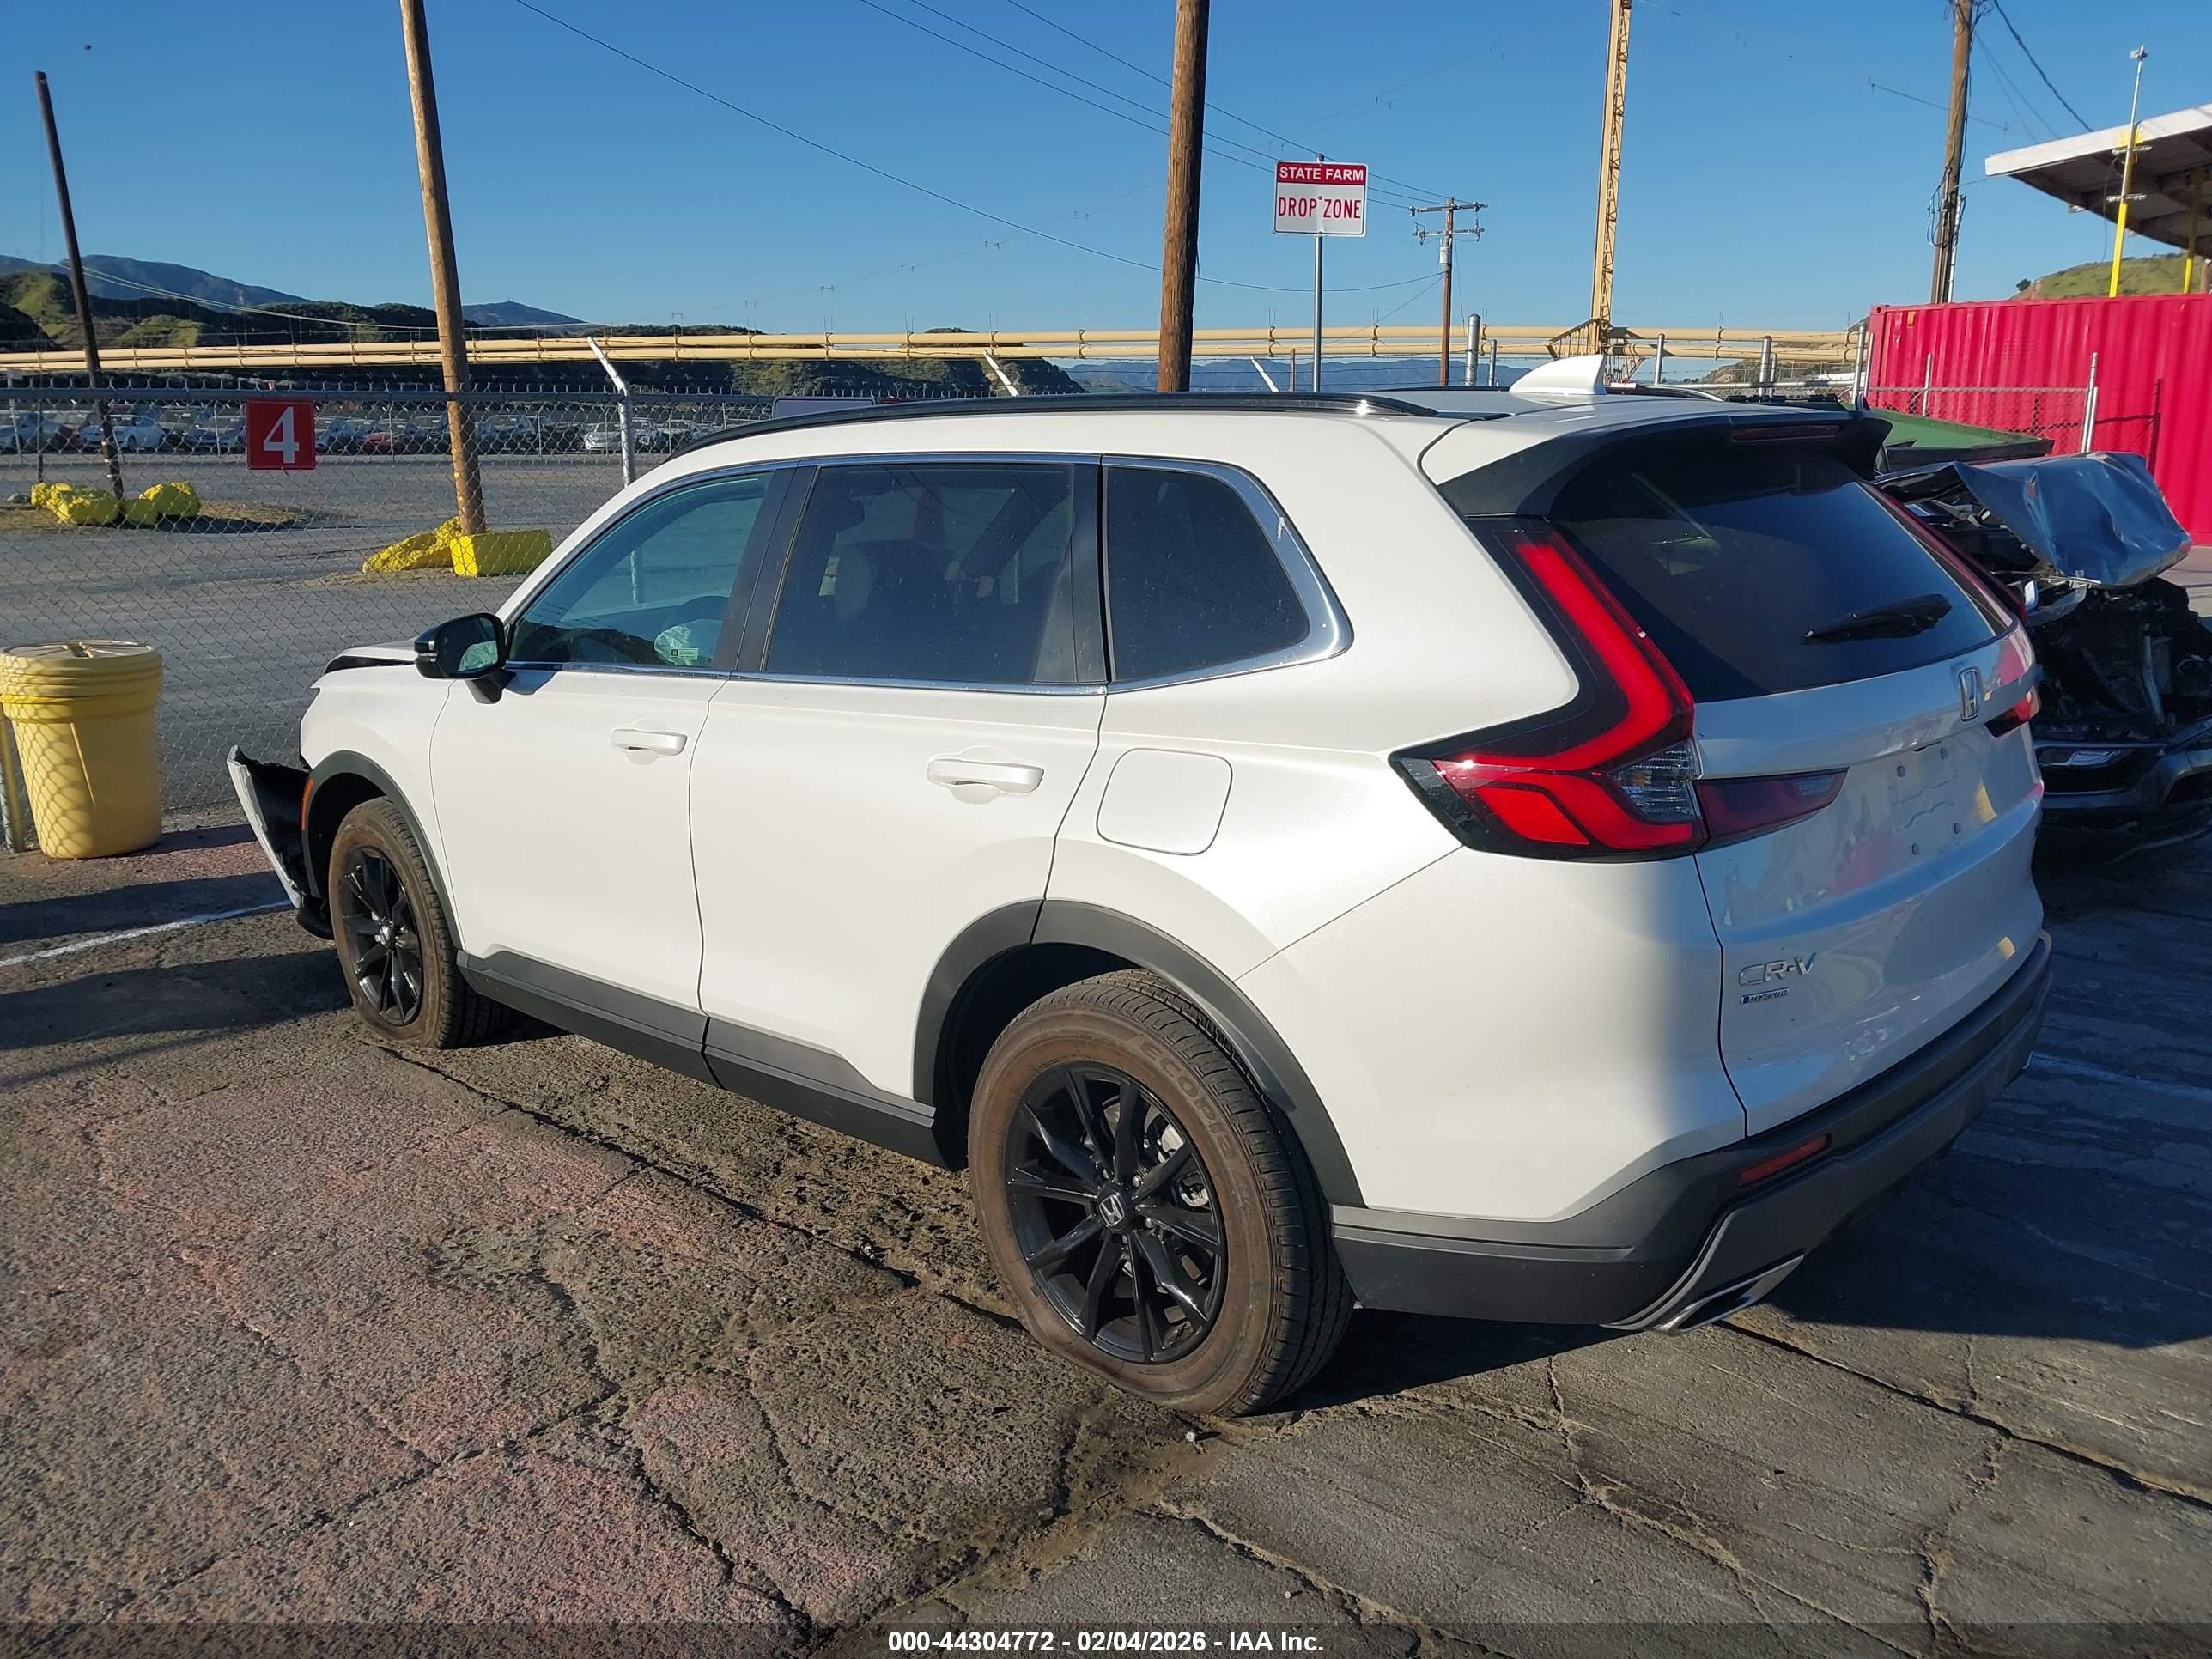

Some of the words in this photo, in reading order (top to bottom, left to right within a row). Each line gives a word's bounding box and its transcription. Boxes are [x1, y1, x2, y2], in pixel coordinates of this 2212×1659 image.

[1279, 167, 1322, 179] STATE
[1325, 168, 1364, 181] FARM
[1278, 197, 1317, 217] DROP
[1322, 198, 1362, 218] ZONE
[263, 406, 300, 464] 4
[1738, 952, 1816, 987] CR-V
[1139, 1040, 1237, 1159] ECOPIA
